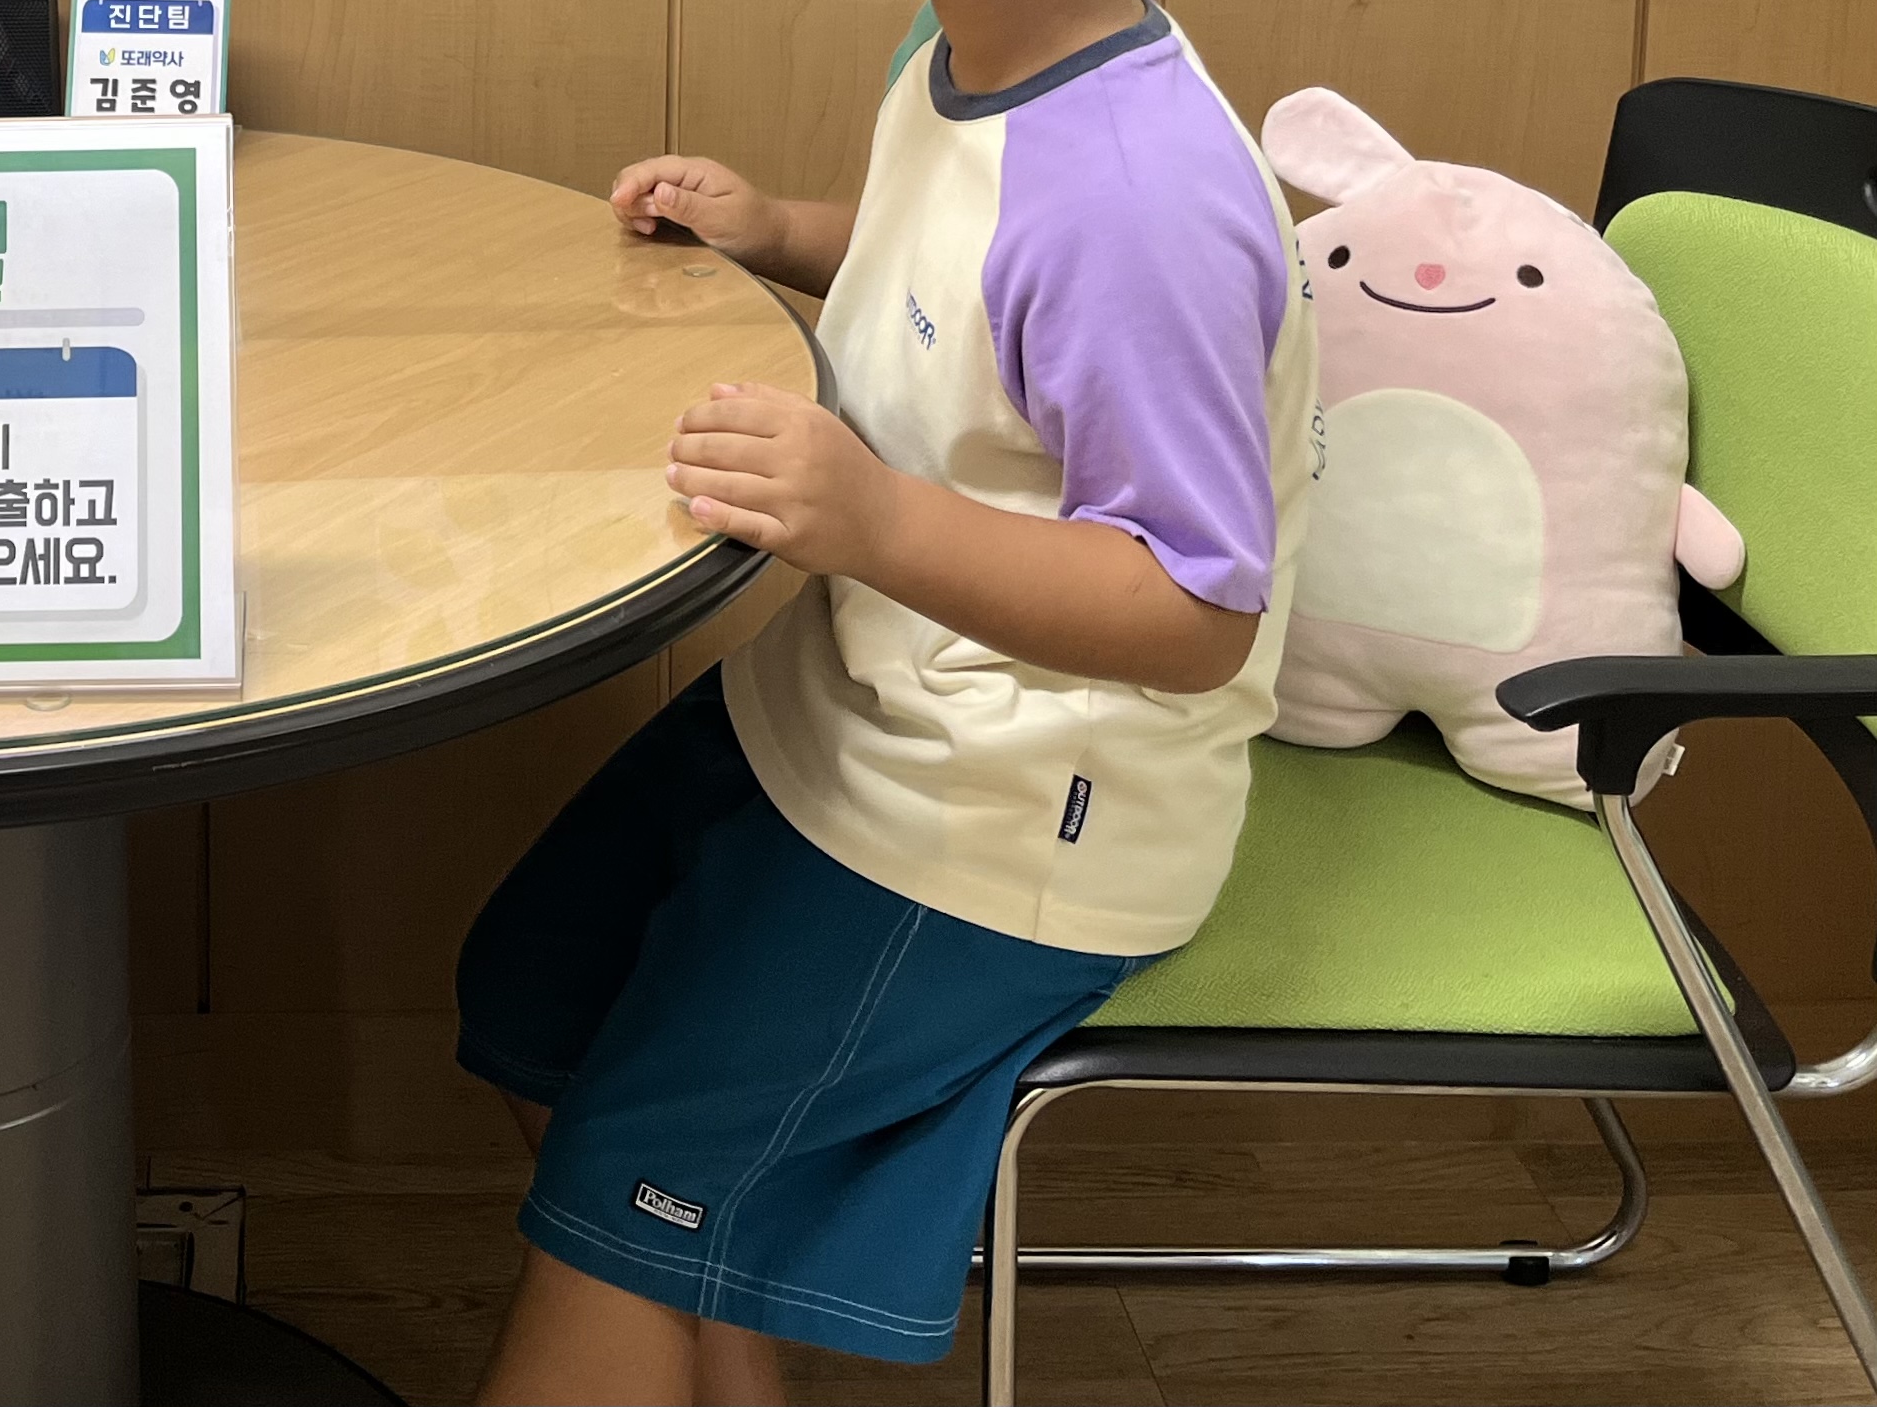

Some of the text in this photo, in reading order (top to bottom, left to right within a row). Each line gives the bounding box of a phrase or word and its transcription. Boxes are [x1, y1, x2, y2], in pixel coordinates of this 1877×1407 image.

[109, 4, 190, 30] 진단팀
[120, 50, 184, 67] 또래약사
[643, 1189, 697, 1222] Polham
